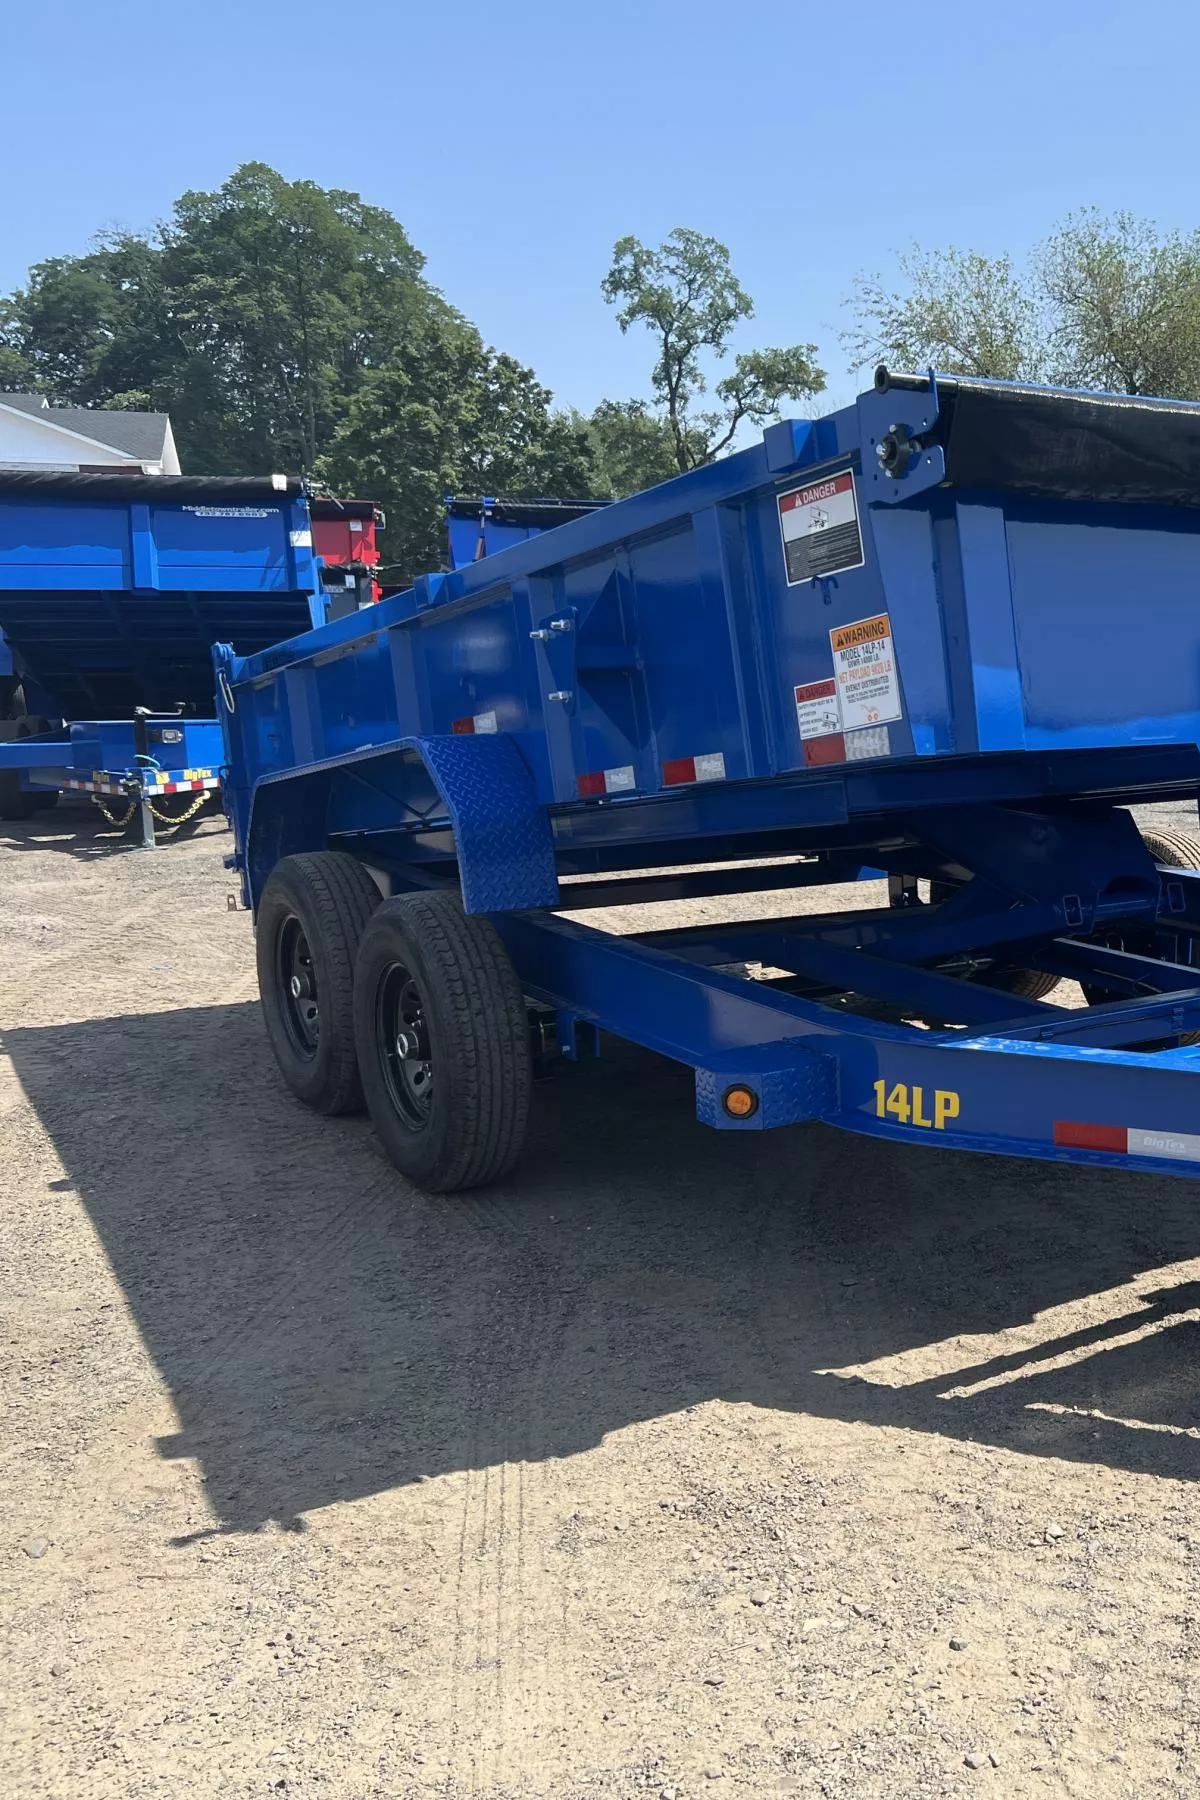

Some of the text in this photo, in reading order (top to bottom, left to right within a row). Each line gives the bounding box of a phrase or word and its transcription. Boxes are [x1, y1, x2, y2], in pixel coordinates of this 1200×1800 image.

[803, 482, 837, 504] DANGER
[843, 622, 885, 645] WARNING
[840, 647, 861, 662] MODEL
[873, 1079, 960, 1129] 14LP
[1143, 1136, 1186, 1150] BigTex
